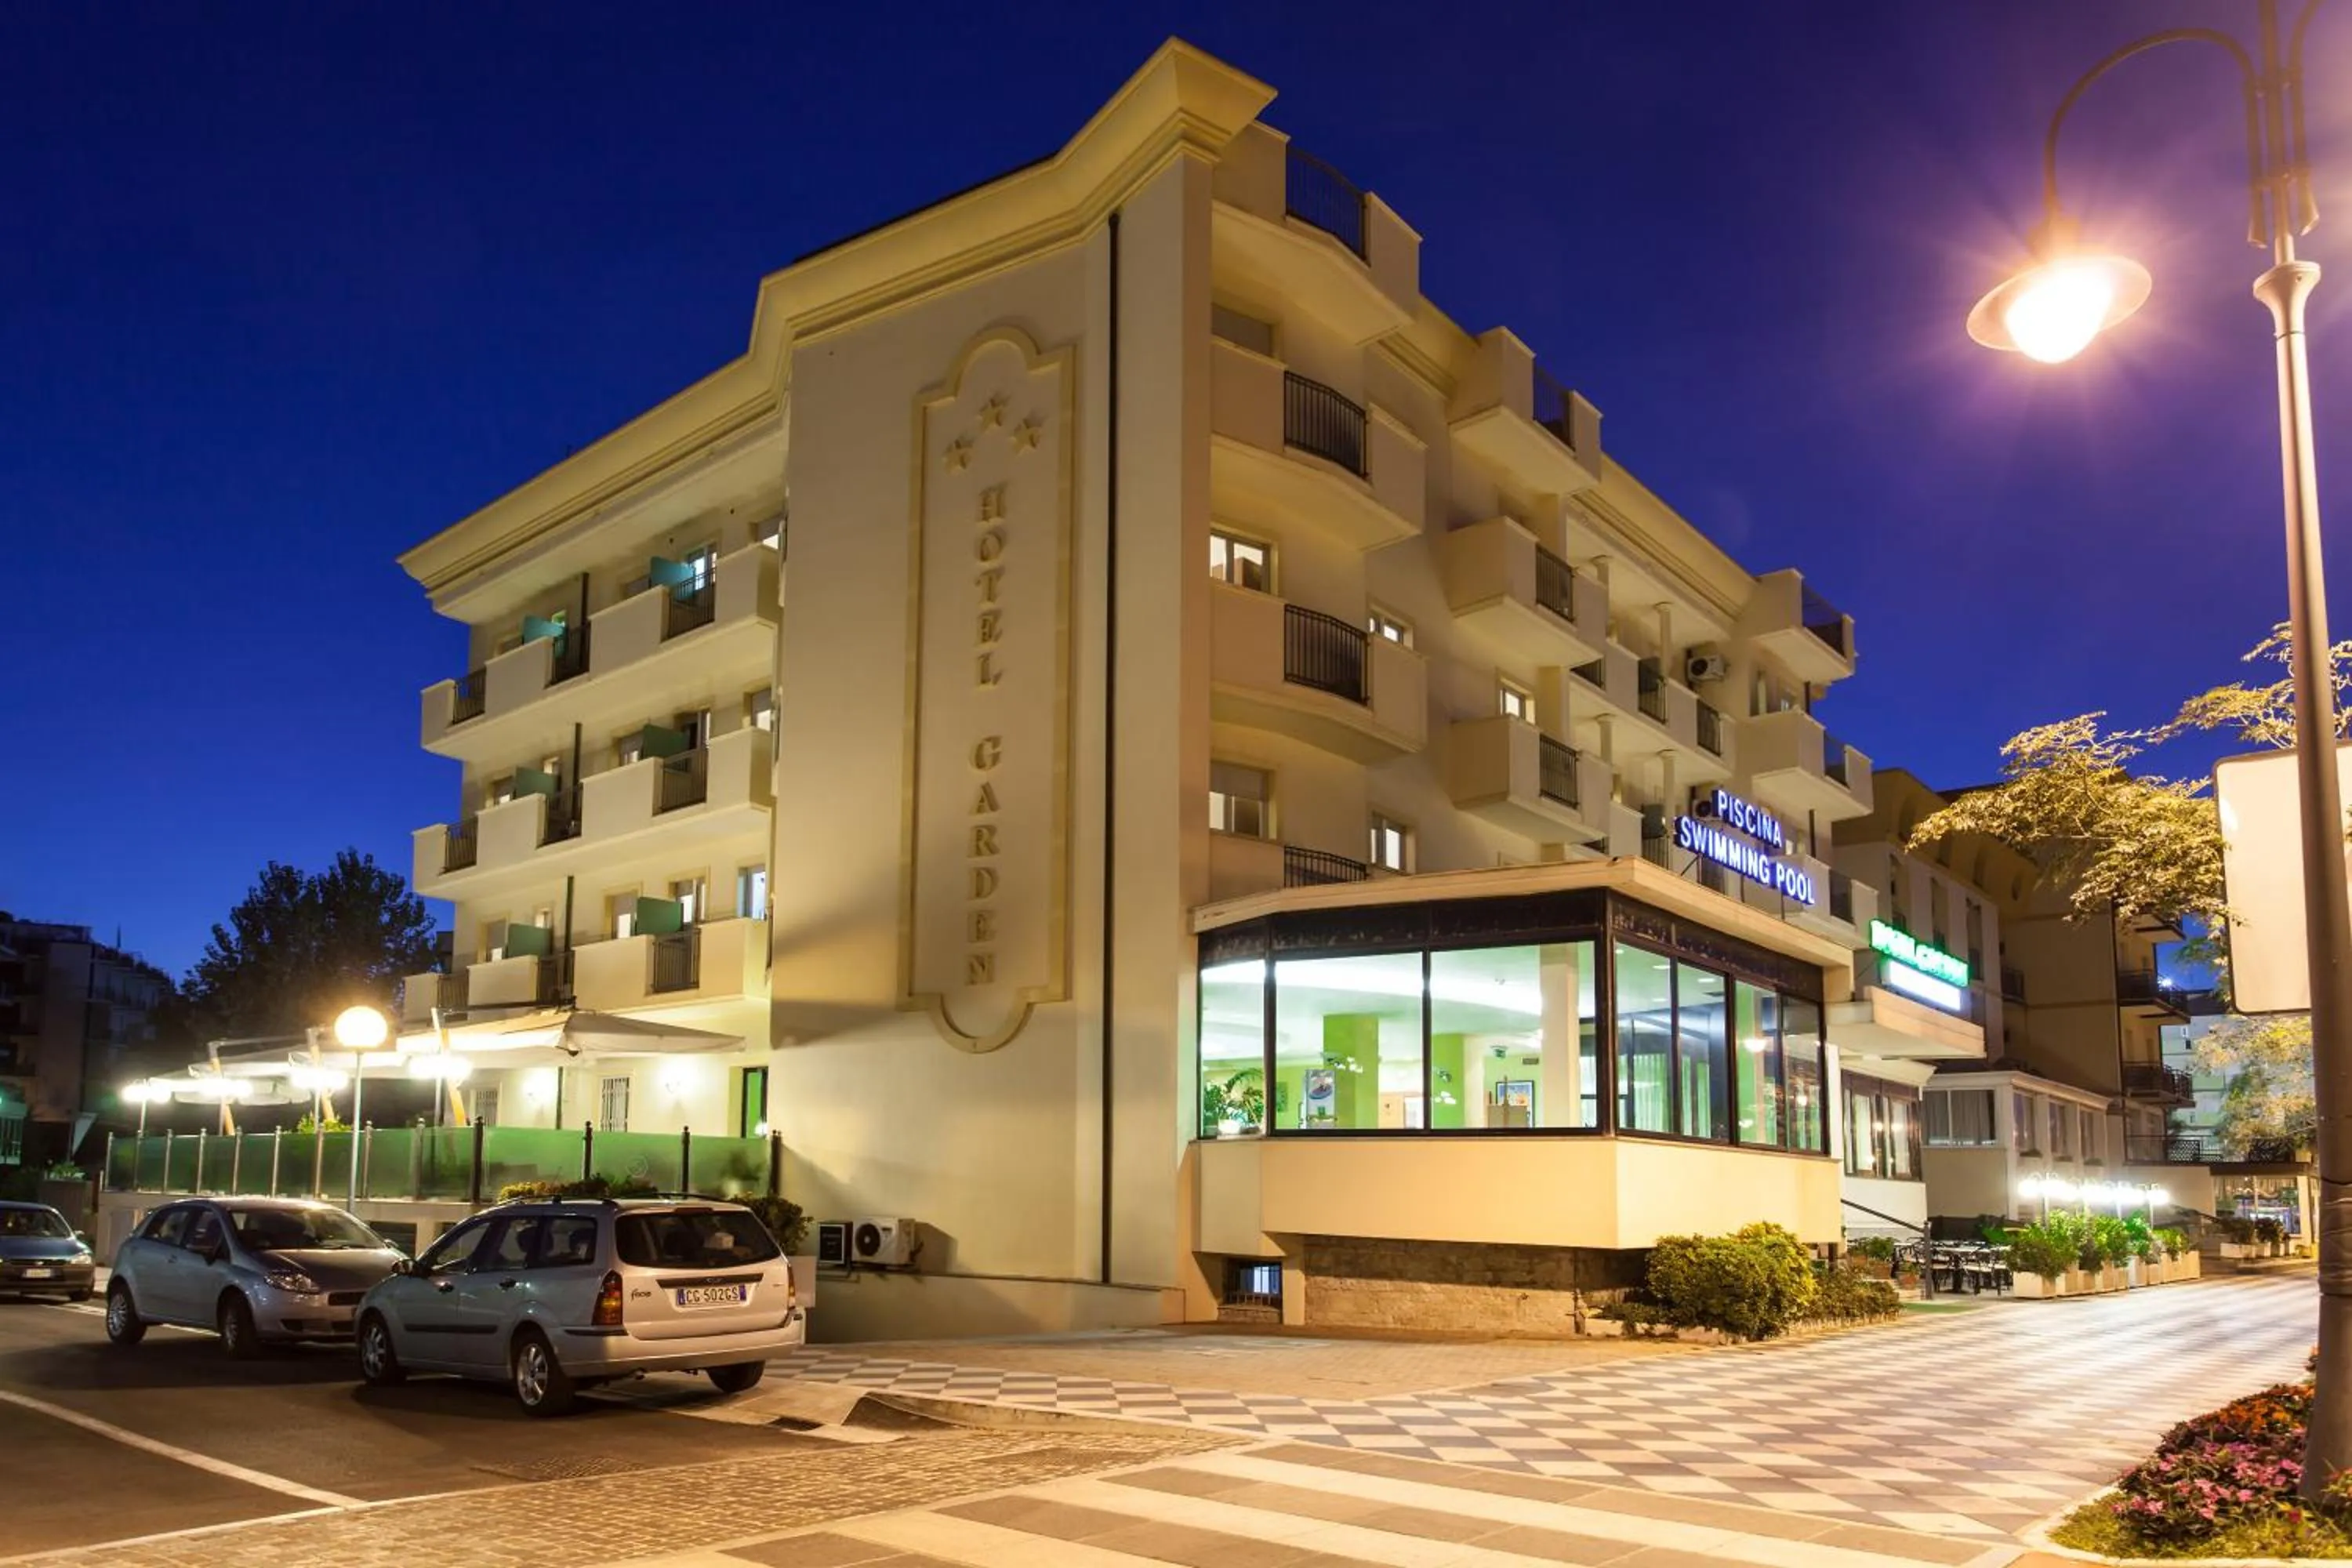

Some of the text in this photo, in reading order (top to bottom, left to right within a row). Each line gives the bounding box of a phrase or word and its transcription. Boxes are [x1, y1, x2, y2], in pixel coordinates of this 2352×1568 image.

[966, 482, 1007, 985] HOTEL GARDEN
[1679, 816, 1816, 904] SWIMMING POOL
[1717, 790, 1782, 848] PISCINA
